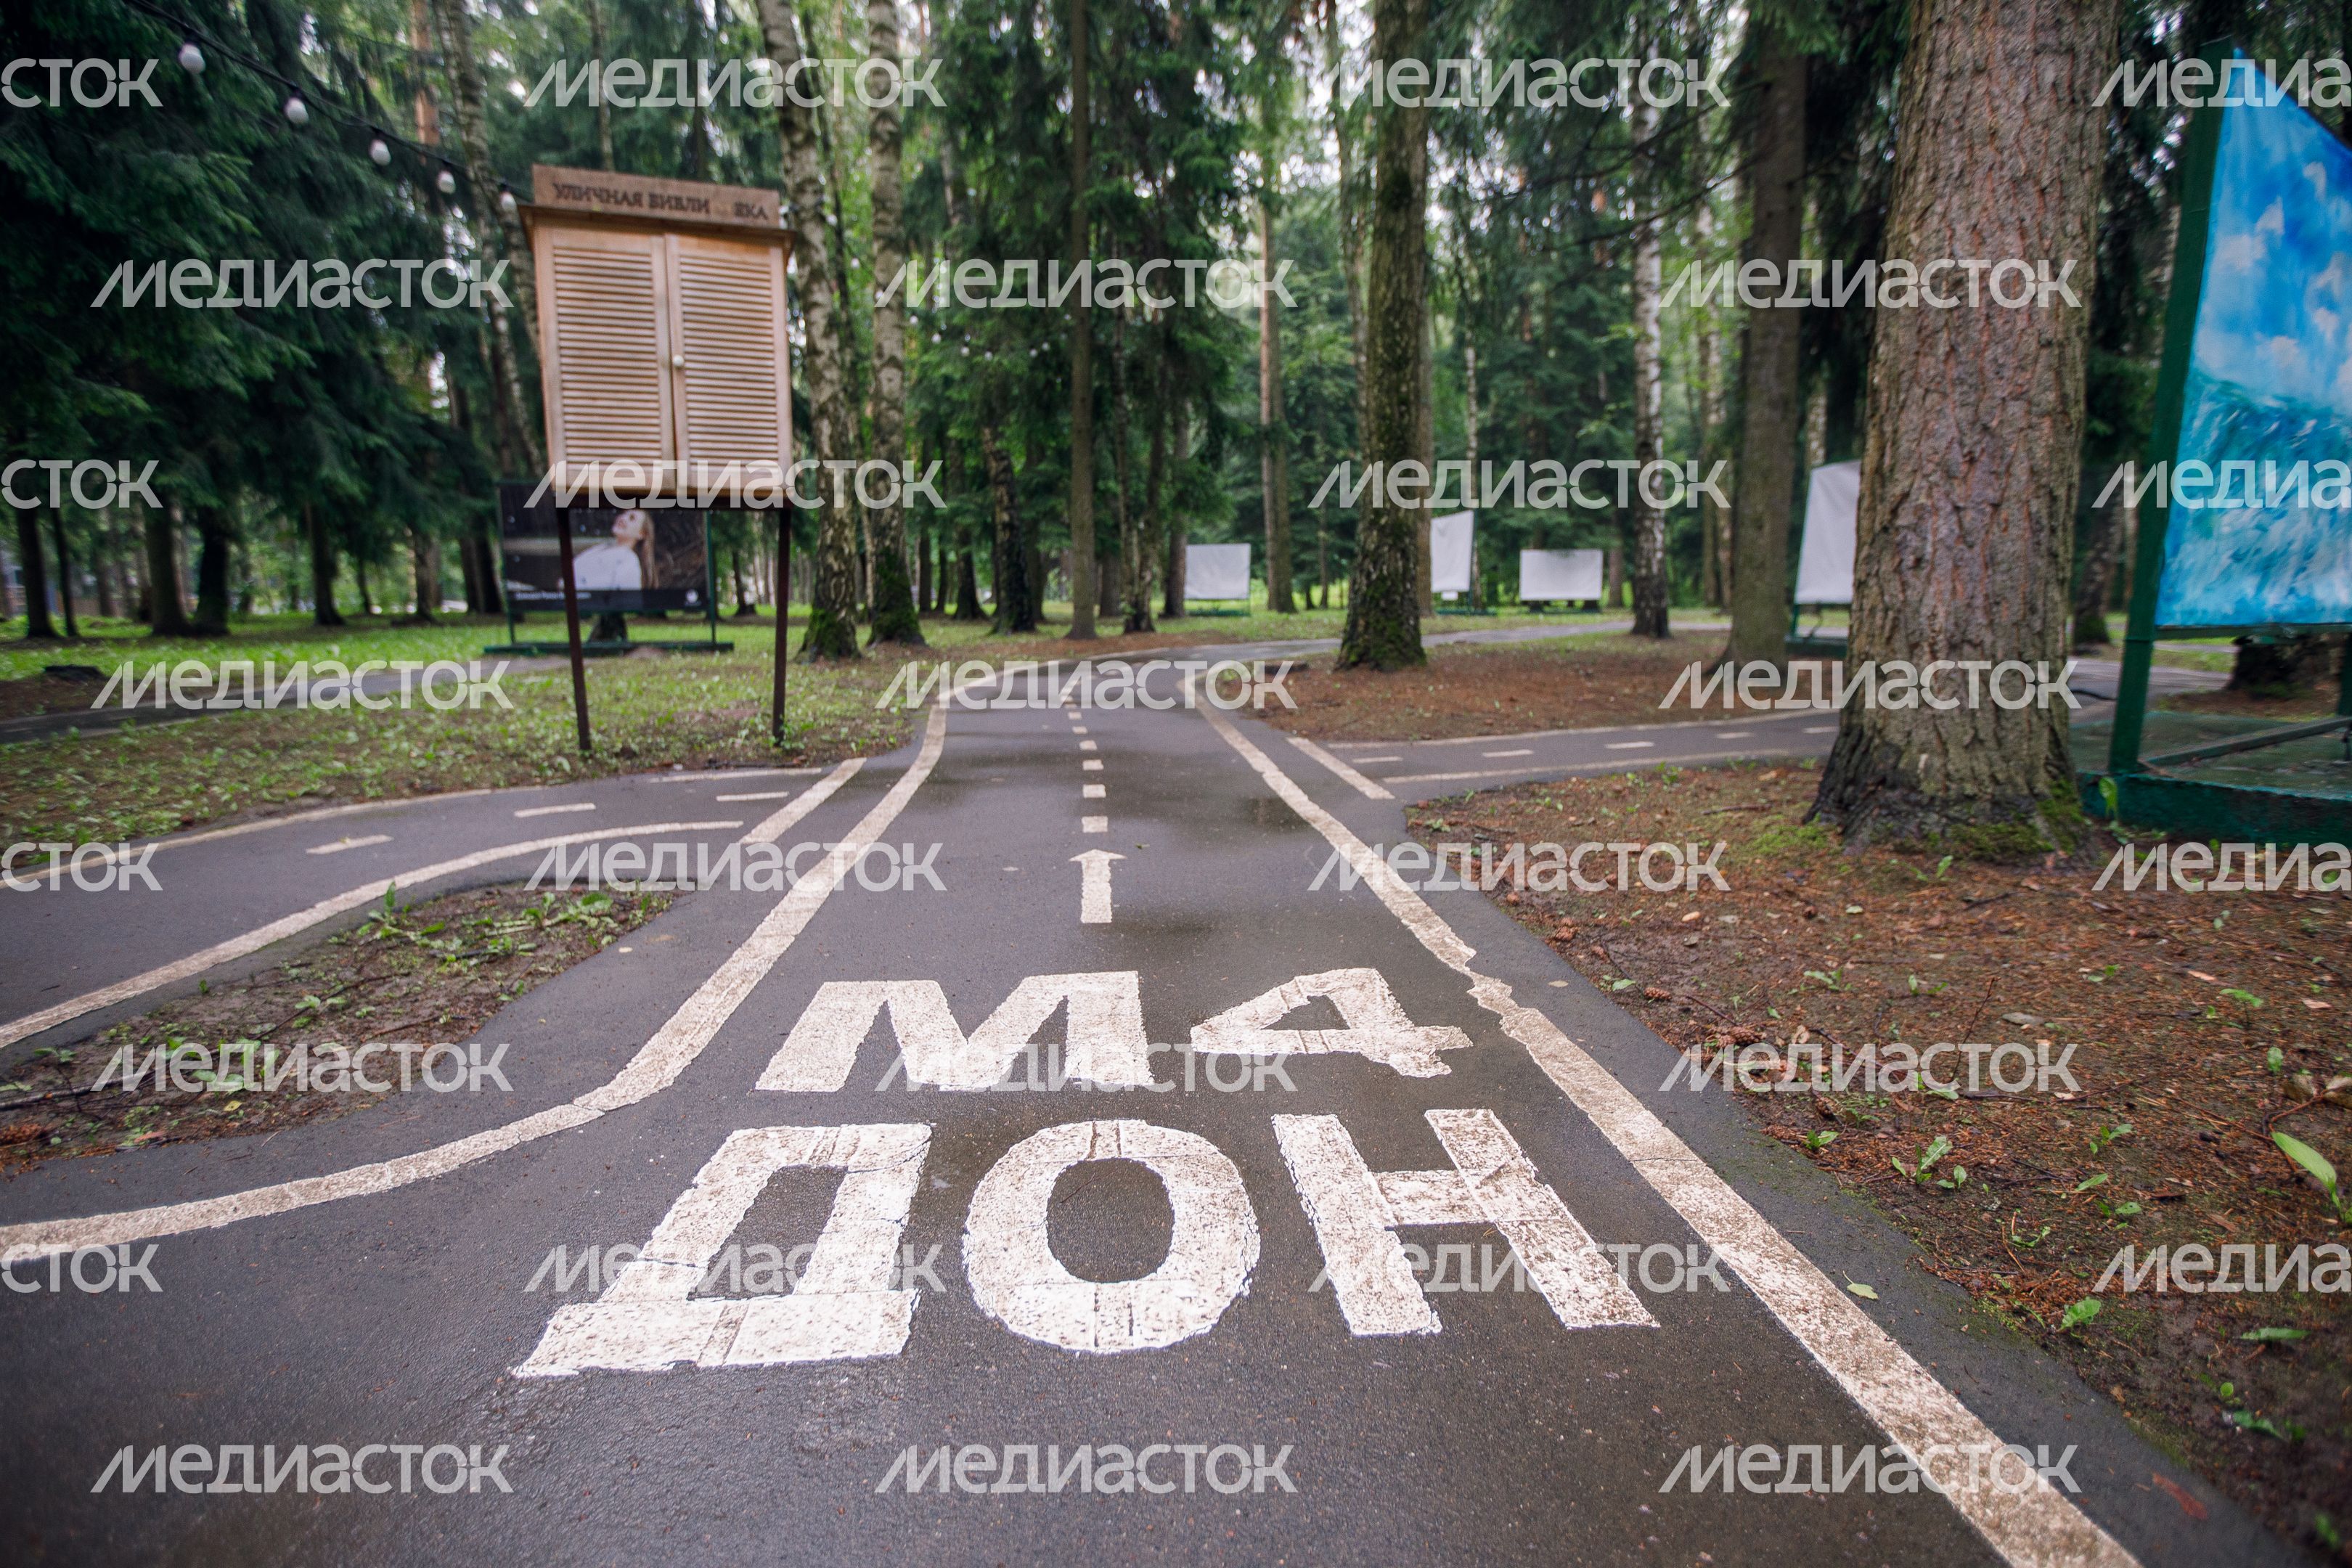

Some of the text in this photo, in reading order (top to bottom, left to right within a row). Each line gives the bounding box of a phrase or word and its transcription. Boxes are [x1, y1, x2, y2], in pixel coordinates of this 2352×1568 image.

[648, 192, 768, 220] БИБЛИЕКА
[756, 968, 1473, 1093] М4
[513, 1108, 1659, 1376] ДОН
